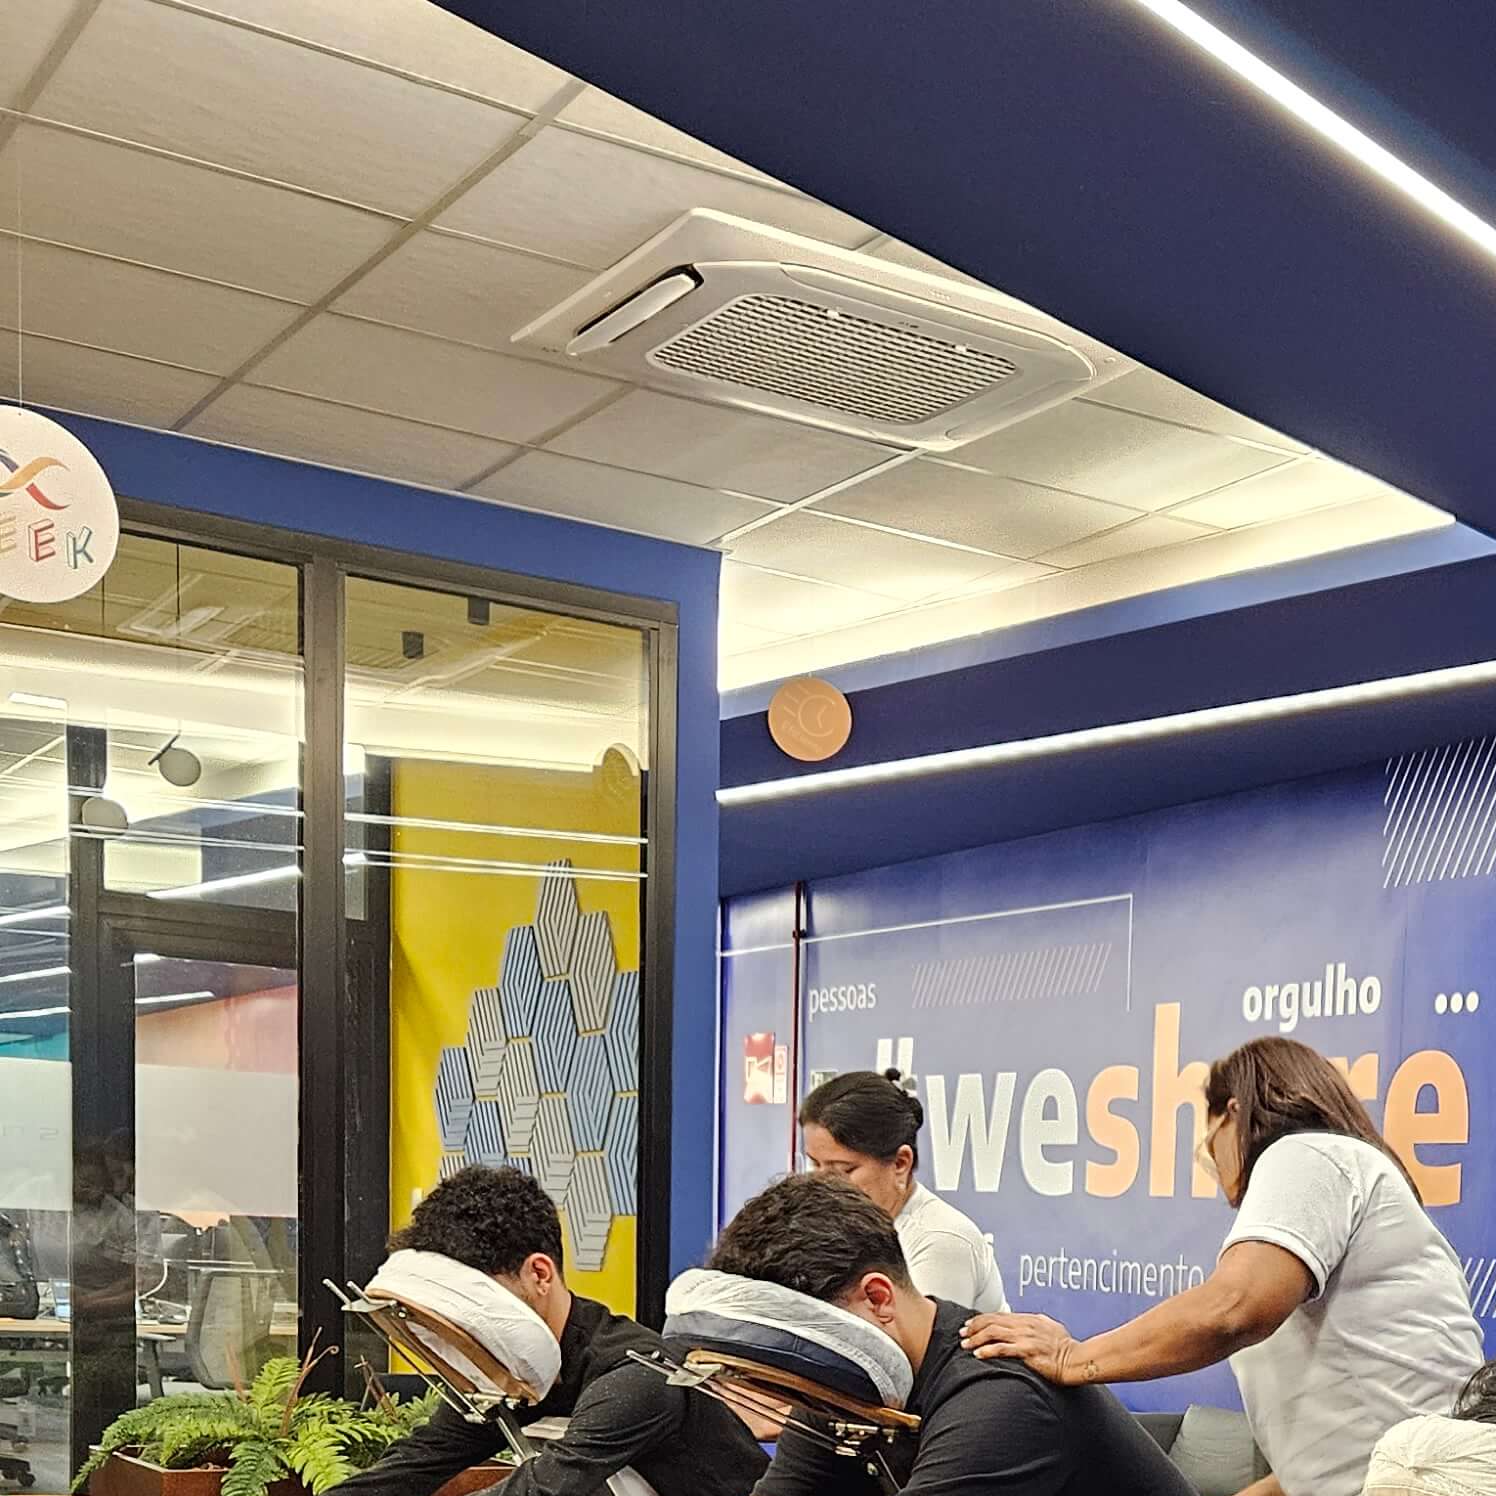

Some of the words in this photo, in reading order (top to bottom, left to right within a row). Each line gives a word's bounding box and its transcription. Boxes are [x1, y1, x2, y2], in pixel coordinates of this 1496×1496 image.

[809, 981, 877, 1021] pessoas
[1243, 963, 1382, 1032] orgulho
[1019, 1248, 1204, 1297] pertencimento
